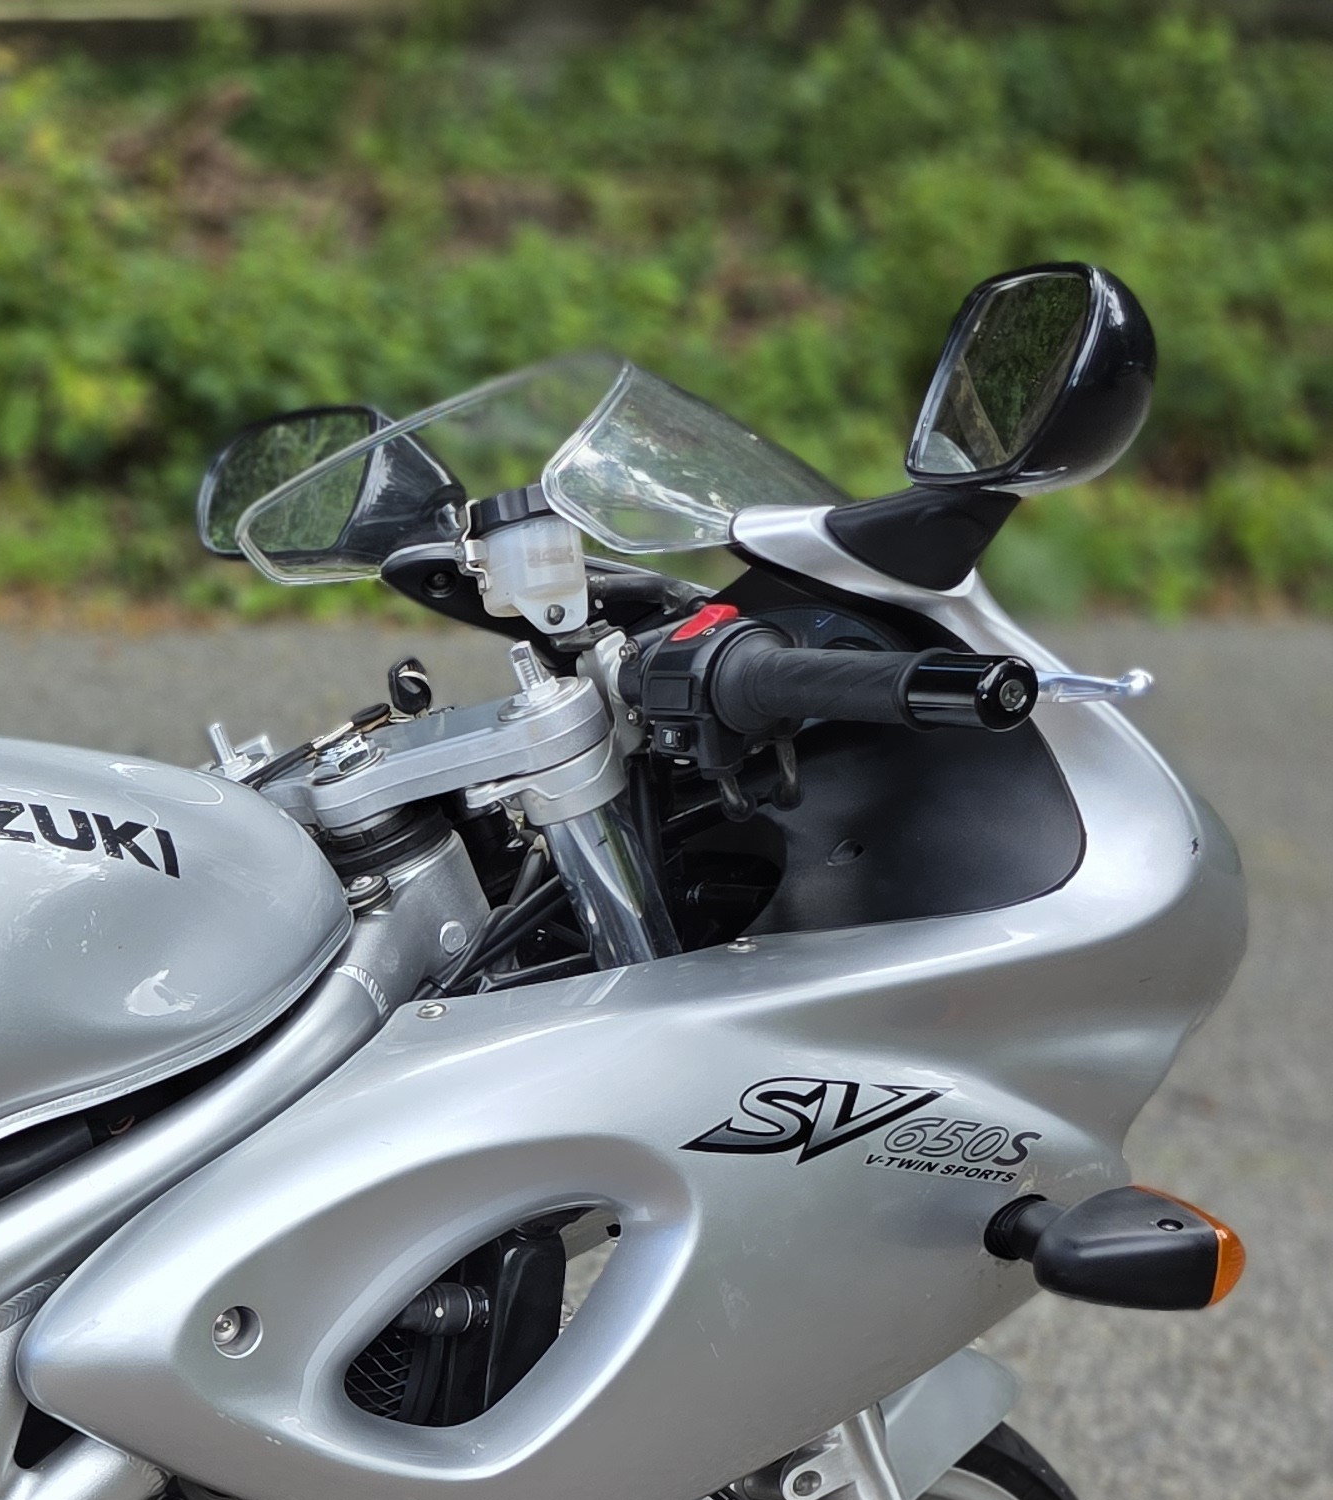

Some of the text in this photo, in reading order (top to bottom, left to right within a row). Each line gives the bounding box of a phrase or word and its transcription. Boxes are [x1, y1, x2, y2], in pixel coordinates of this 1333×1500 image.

[679, 1076, 1042, 1166] SV 650S
[865, 1154, 1017, 1184] V-TWIN SPORTS
